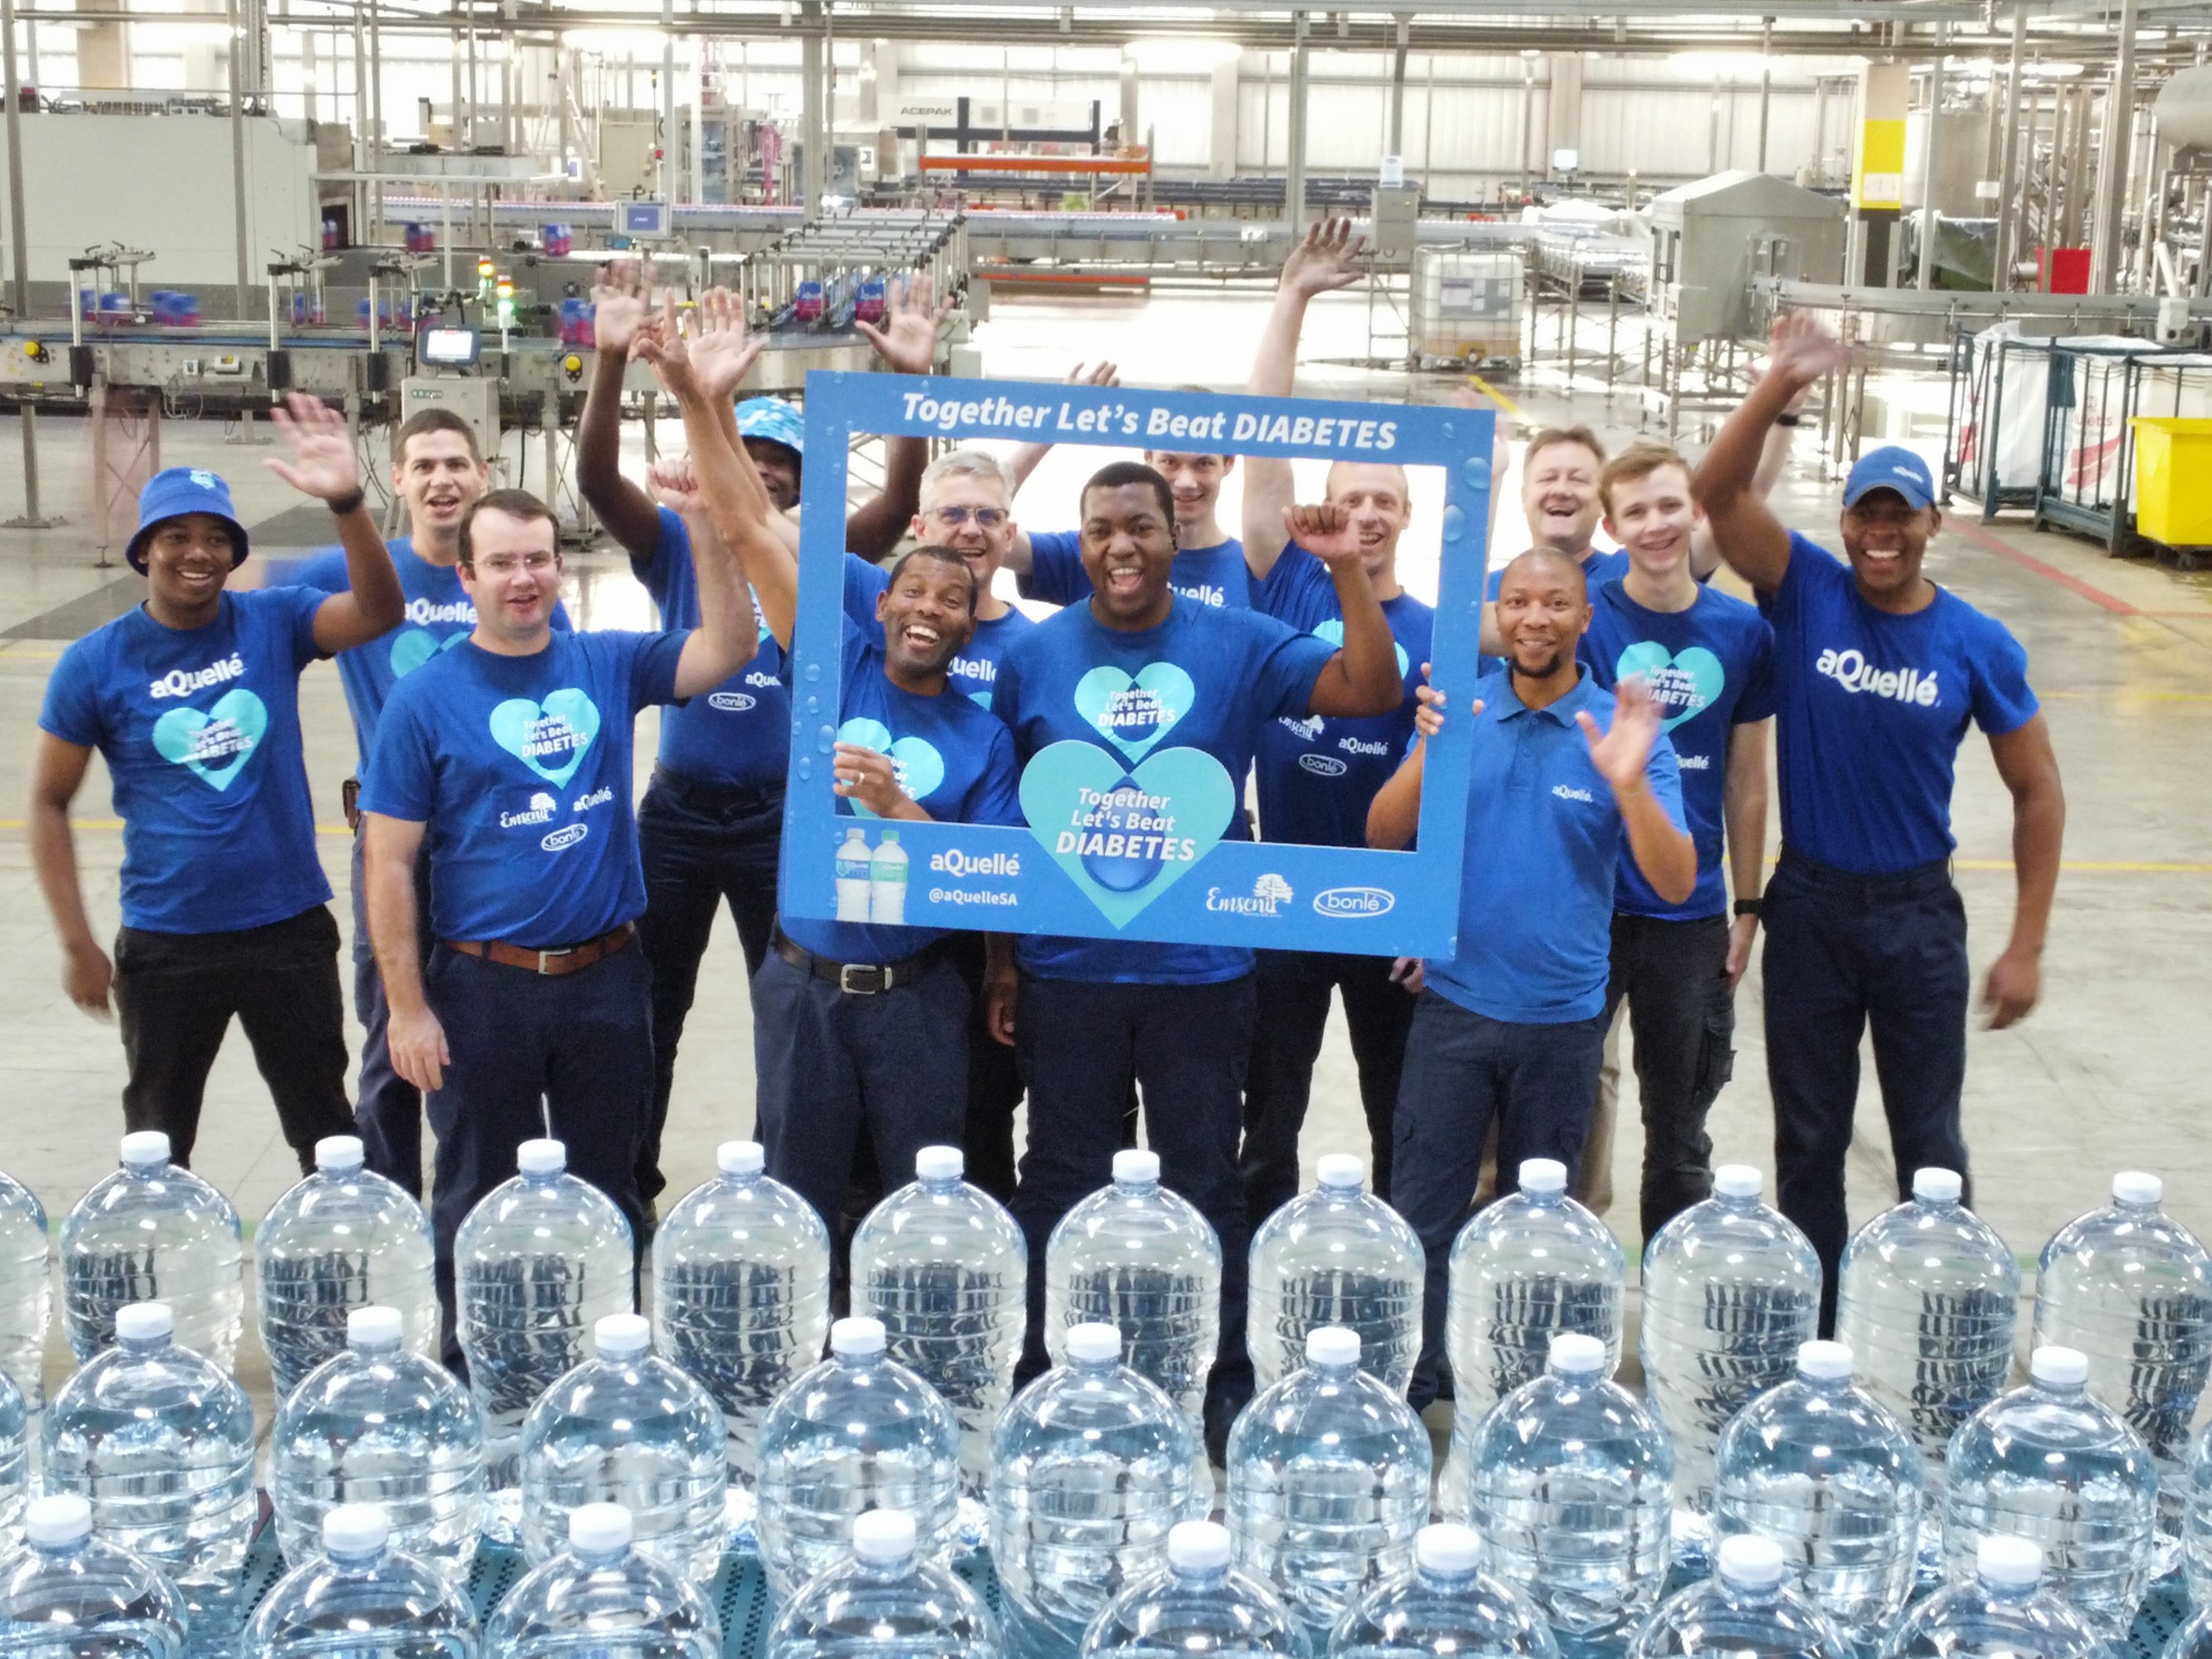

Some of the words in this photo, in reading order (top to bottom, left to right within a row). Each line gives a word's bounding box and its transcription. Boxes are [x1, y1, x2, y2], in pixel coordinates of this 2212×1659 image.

[900, 106, 953, 115] ACEPAK
[903, 392, 1052, 430] Together
[1146, 407, 1227, 440] Beat
[1232, 413, 1398, 450] DIABETES
[150, 652, 245, 698] aQuellé
[1816, 649, 1938, 707] aQuellé
[1110, 688, 1158, 702] Together
[1135, 699, 1163, 710] Beat
[1646, 688, 1706, 708] IABETES
[523, 715, 566, 732] Together
[1097, 709, 1176, 727] DIABETES
[548, 723, 574, 737] Beat
[522, 732, 589, 757] DIABETES
[1338, 737, 1388, 756] aQuellé
[573, 786, 613, 812] aQuellé
[1078, 787, 1171, 810] Together
[1071, 810, 1121, 829] Let's
[1125, 812, 1176, 832] Beat
[1055, 830, 1197, 862] DIABETES
[930, 849, 1021, 877] aQuellé
[928, 888, 1018, 907] @aQuelleSA
[1327, 892, 1380, 911] bonlé
